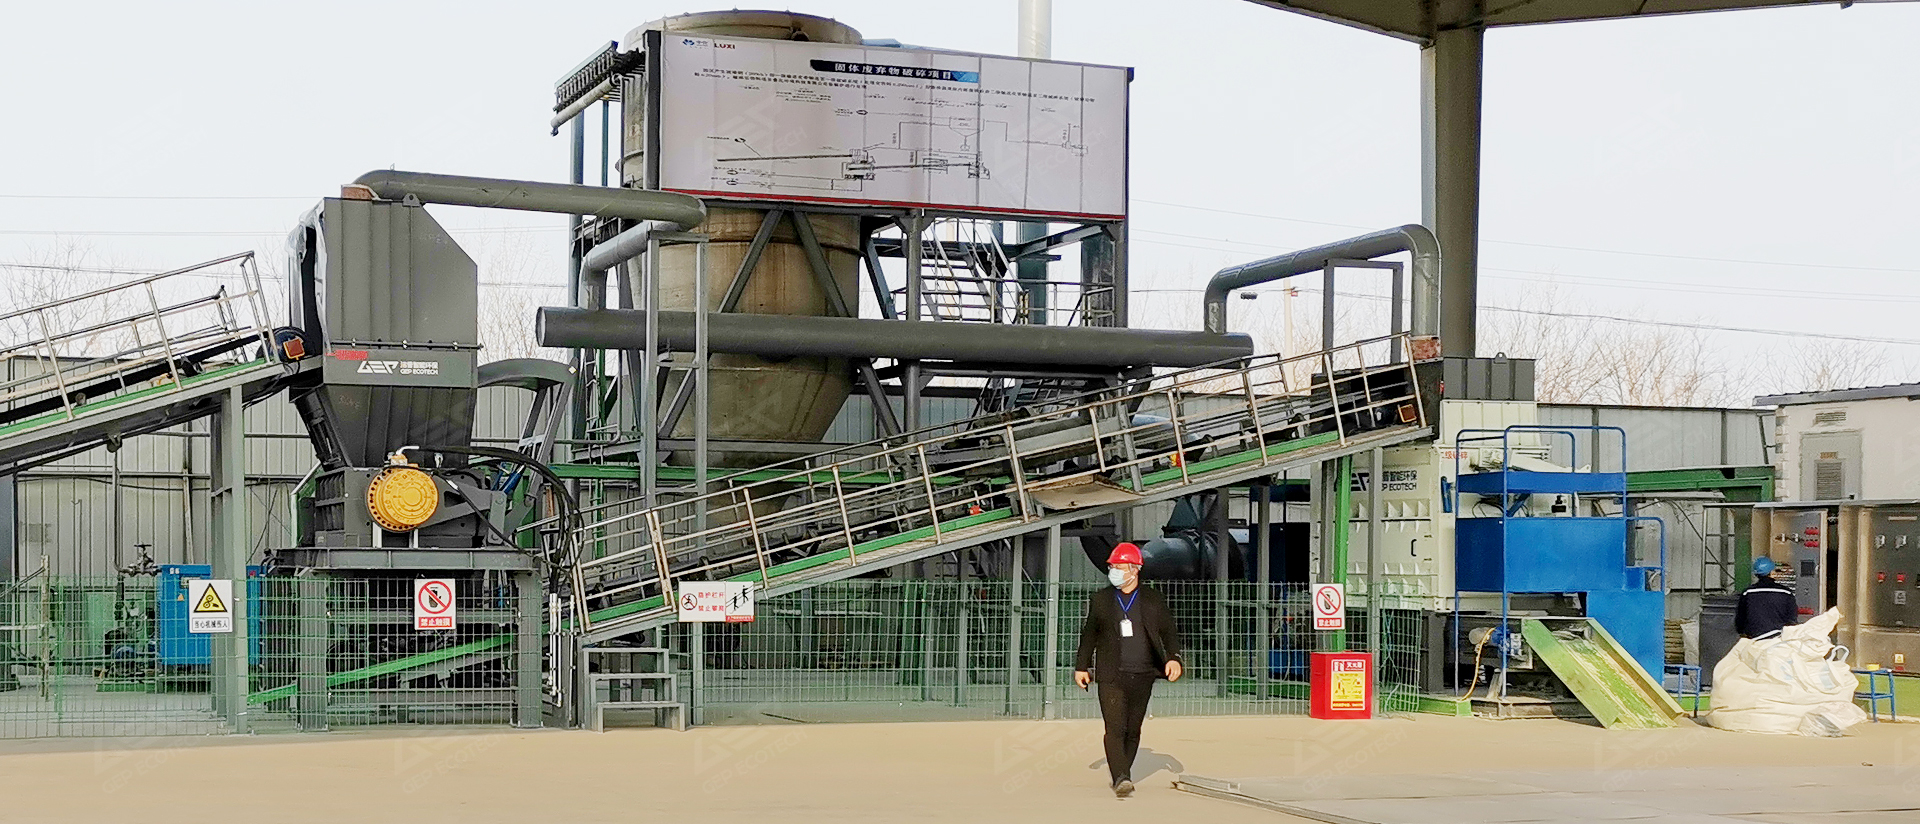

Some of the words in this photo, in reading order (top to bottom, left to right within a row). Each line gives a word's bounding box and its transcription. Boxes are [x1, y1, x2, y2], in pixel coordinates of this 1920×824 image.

[834, 62, 951, 80] 固体废弃物破碎项目
[357, 361, 399, 374] GEP
[1388, 482, 1417, 491] ECOTECH
